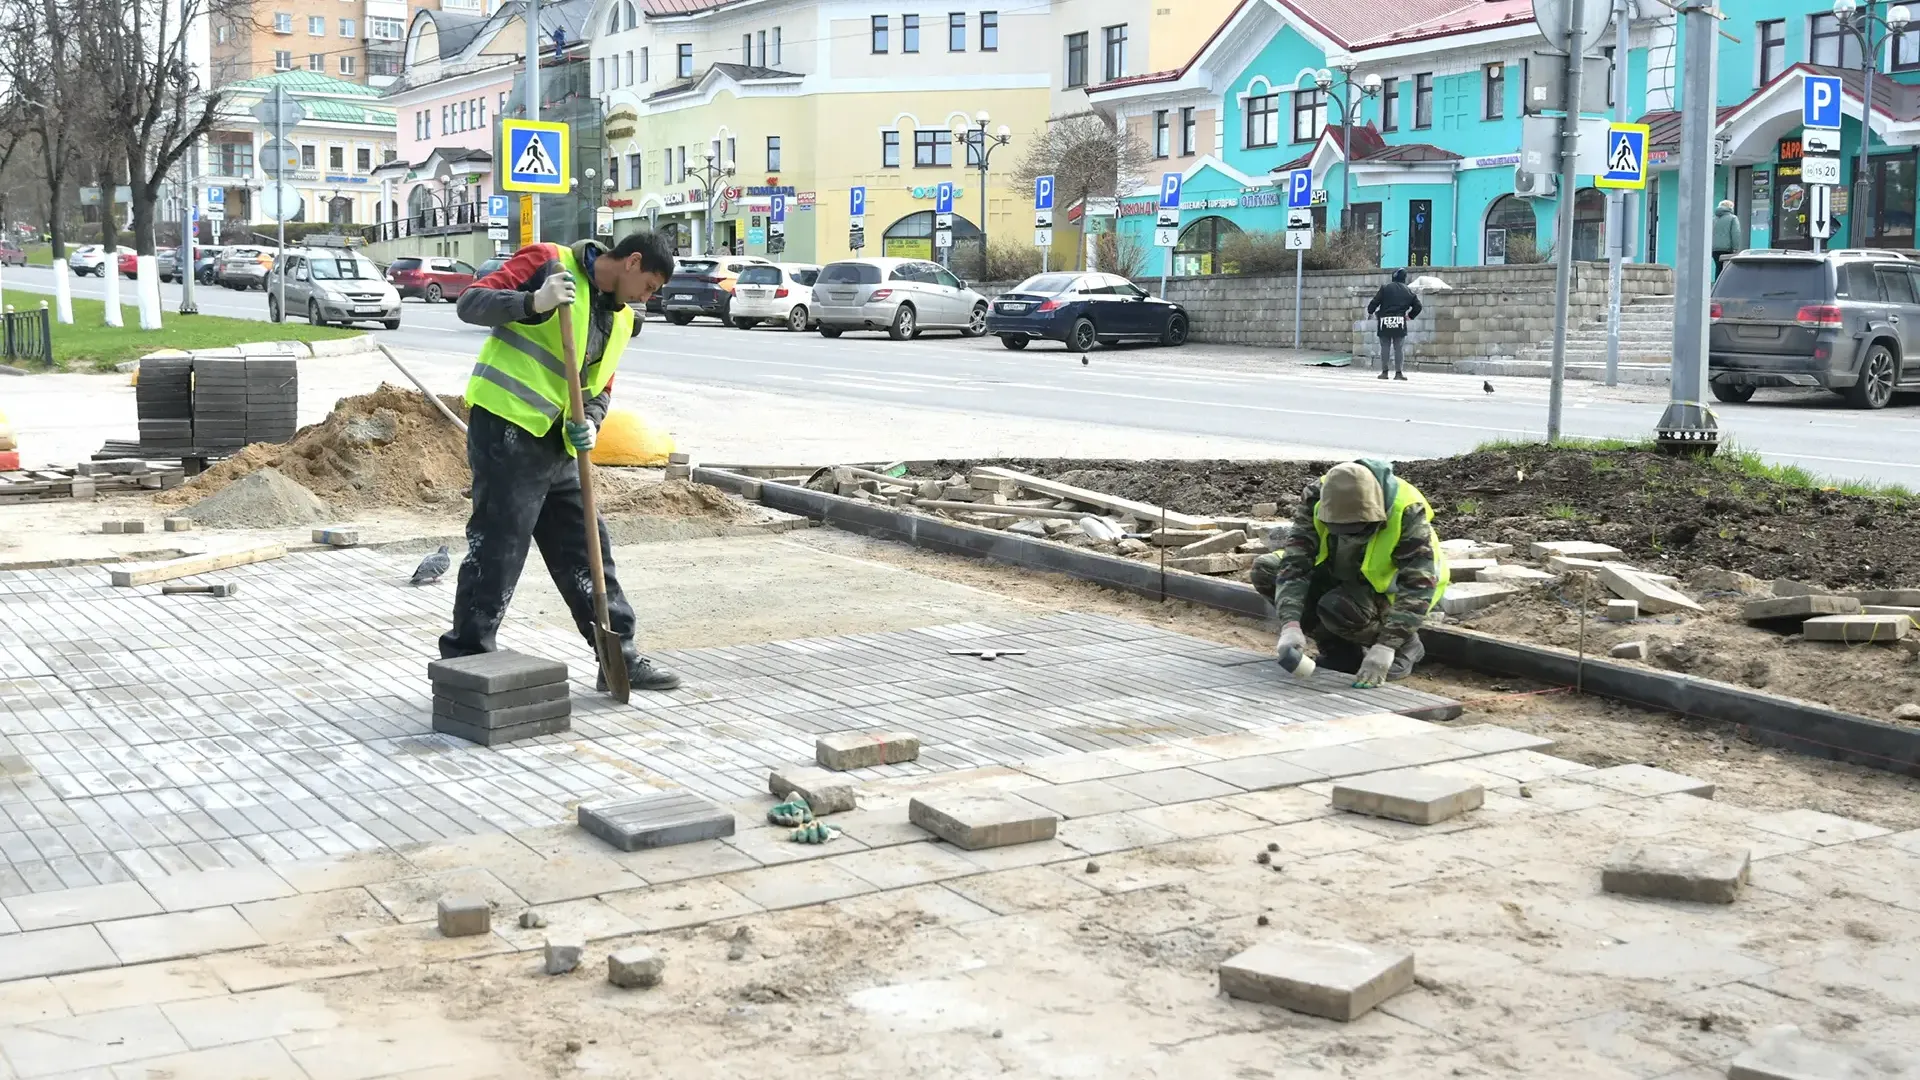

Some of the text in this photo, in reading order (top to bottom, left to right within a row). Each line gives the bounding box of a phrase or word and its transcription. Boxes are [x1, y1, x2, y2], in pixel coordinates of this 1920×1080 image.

[1813, 82, 1832, 121] P
[1781, 141, 1805, 160] БАРРА
[1815, 167, 1823, 175] 15
[1825, 166, 1836, 177] 20
[211, 189, 220, 200] P
[746, 185, 796, 198] ЛОМБАРД
[940, 185, 950, 210] P
[1040, 179, 1051, 206] P
[1165, 176, 1178, 203] P
[1294, 173, 1308, 203] P
[1312, 189, 1328, 203] АРД
[493, 198, 503, 215] P
[773, 197, 783, 220] P
[853, 189, 863, 213] P
[1241, 192, 1280, 209] ОПТИКА
